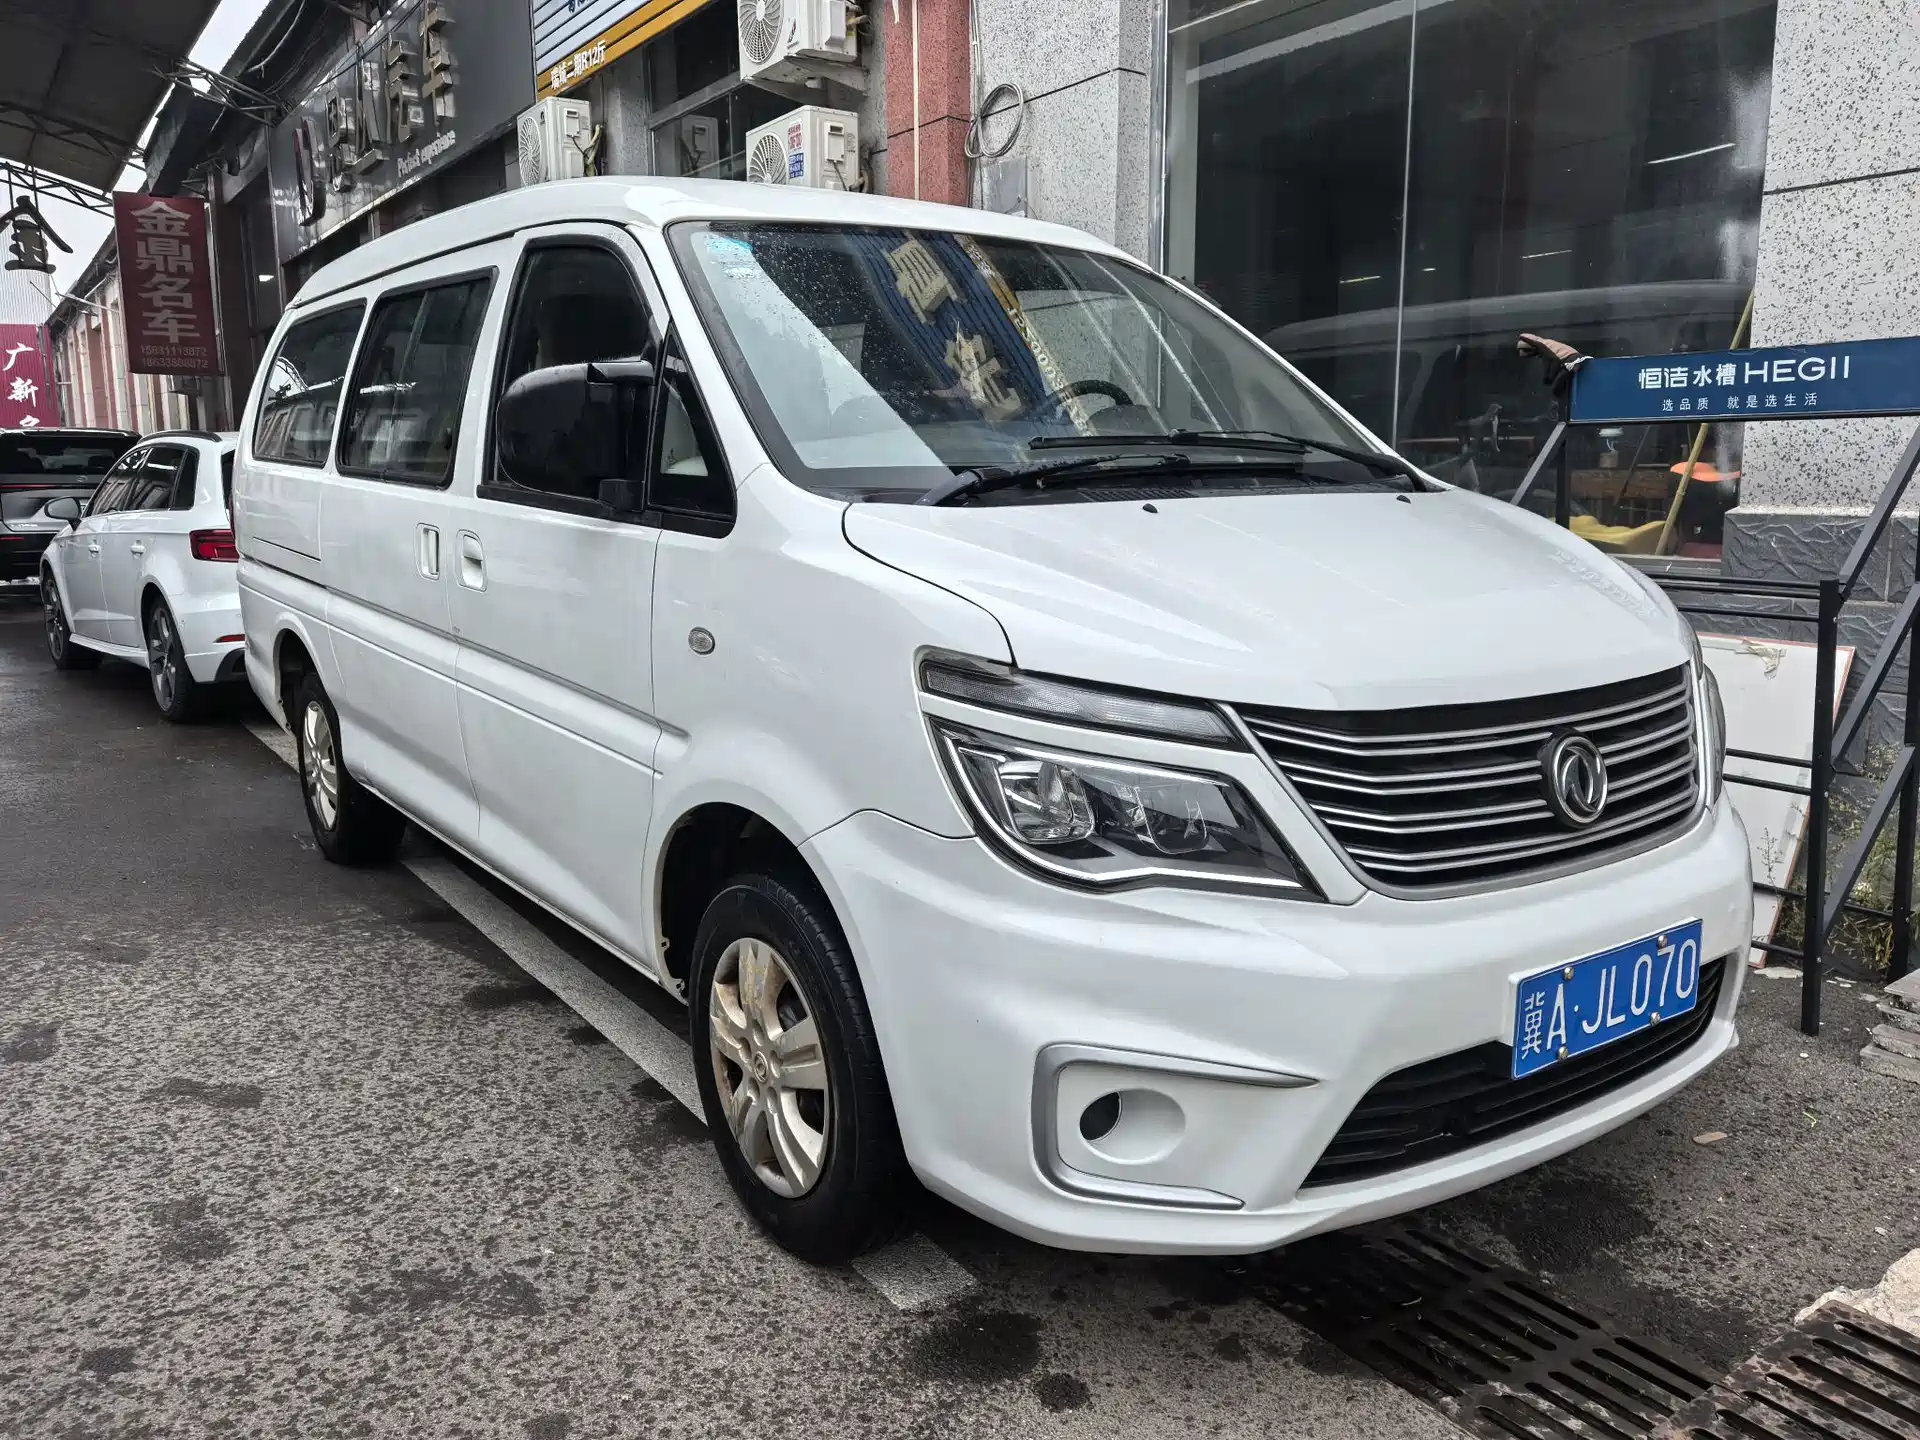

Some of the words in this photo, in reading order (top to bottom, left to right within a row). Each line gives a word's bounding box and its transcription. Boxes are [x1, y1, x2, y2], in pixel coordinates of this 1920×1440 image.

[130, 200, 200, 344] 金鼎名车
[1638, 363, 1737, 391] 恒洁水槽
[1744, 355, 1850, 384] HEGII
[1661, 397, 1709, 412] 选品质
[1726, 391, 1818, 409] 就是选生活
